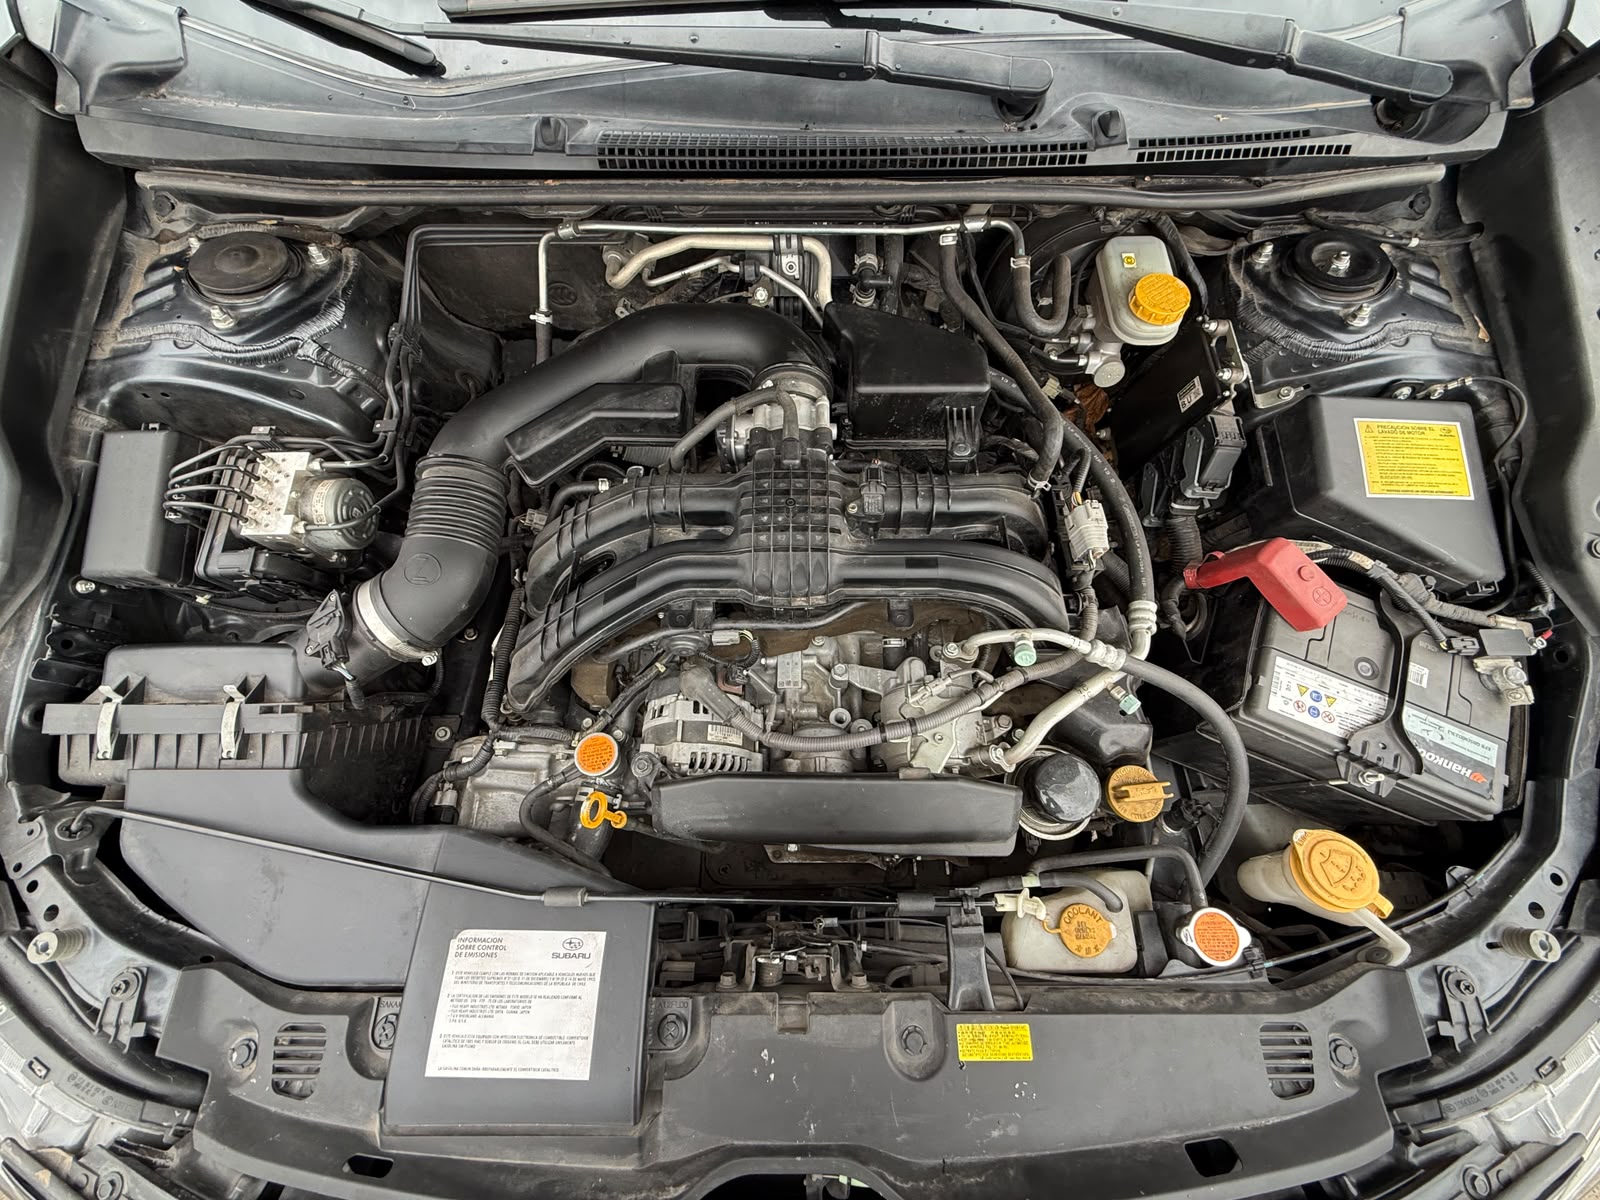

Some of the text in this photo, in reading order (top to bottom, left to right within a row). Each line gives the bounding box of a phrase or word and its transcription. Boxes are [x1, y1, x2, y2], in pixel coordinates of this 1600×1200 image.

[1417, 747, 1472, 778] Hankoo
[1063, 906, 1103, 925] COOLANT
[464, 951, 498, 959] EMISIONES
